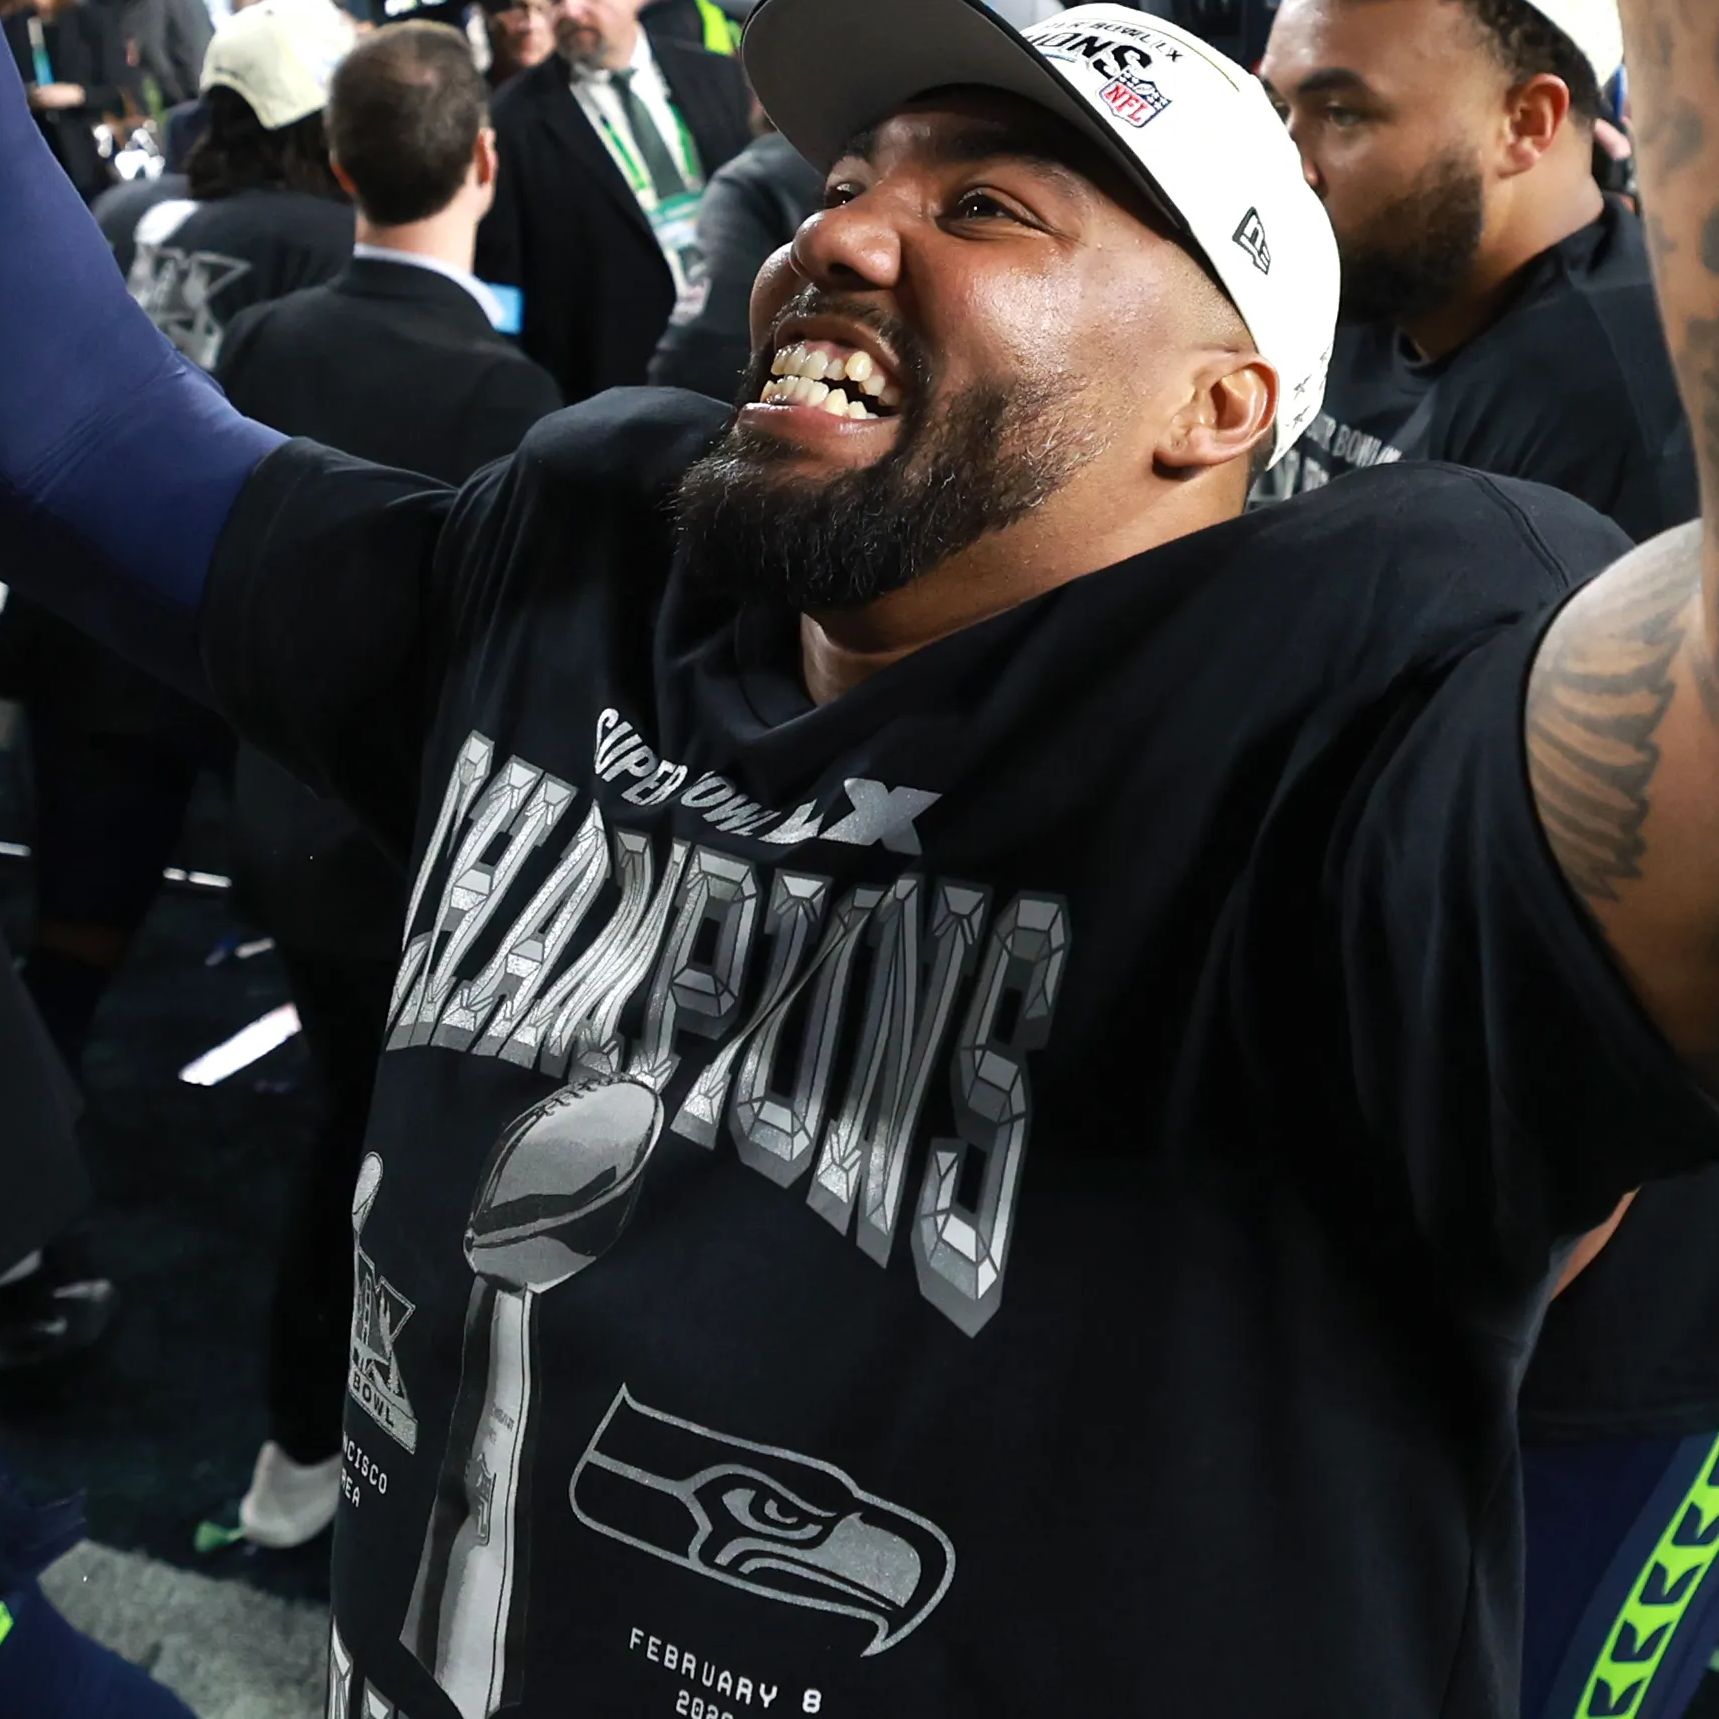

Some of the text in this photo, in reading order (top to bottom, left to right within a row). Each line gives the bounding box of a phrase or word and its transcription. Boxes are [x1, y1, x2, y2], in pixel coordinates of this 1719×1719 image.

[1089, 22, 1151, 44] BOWL
[1104, 83, 1149, 123] NFL
[594, 707, 688, 806] SUPER
[352, 1371, 395, 1429] BOWL
[629, 1626, 823, 1714] FEBRUARY 8
